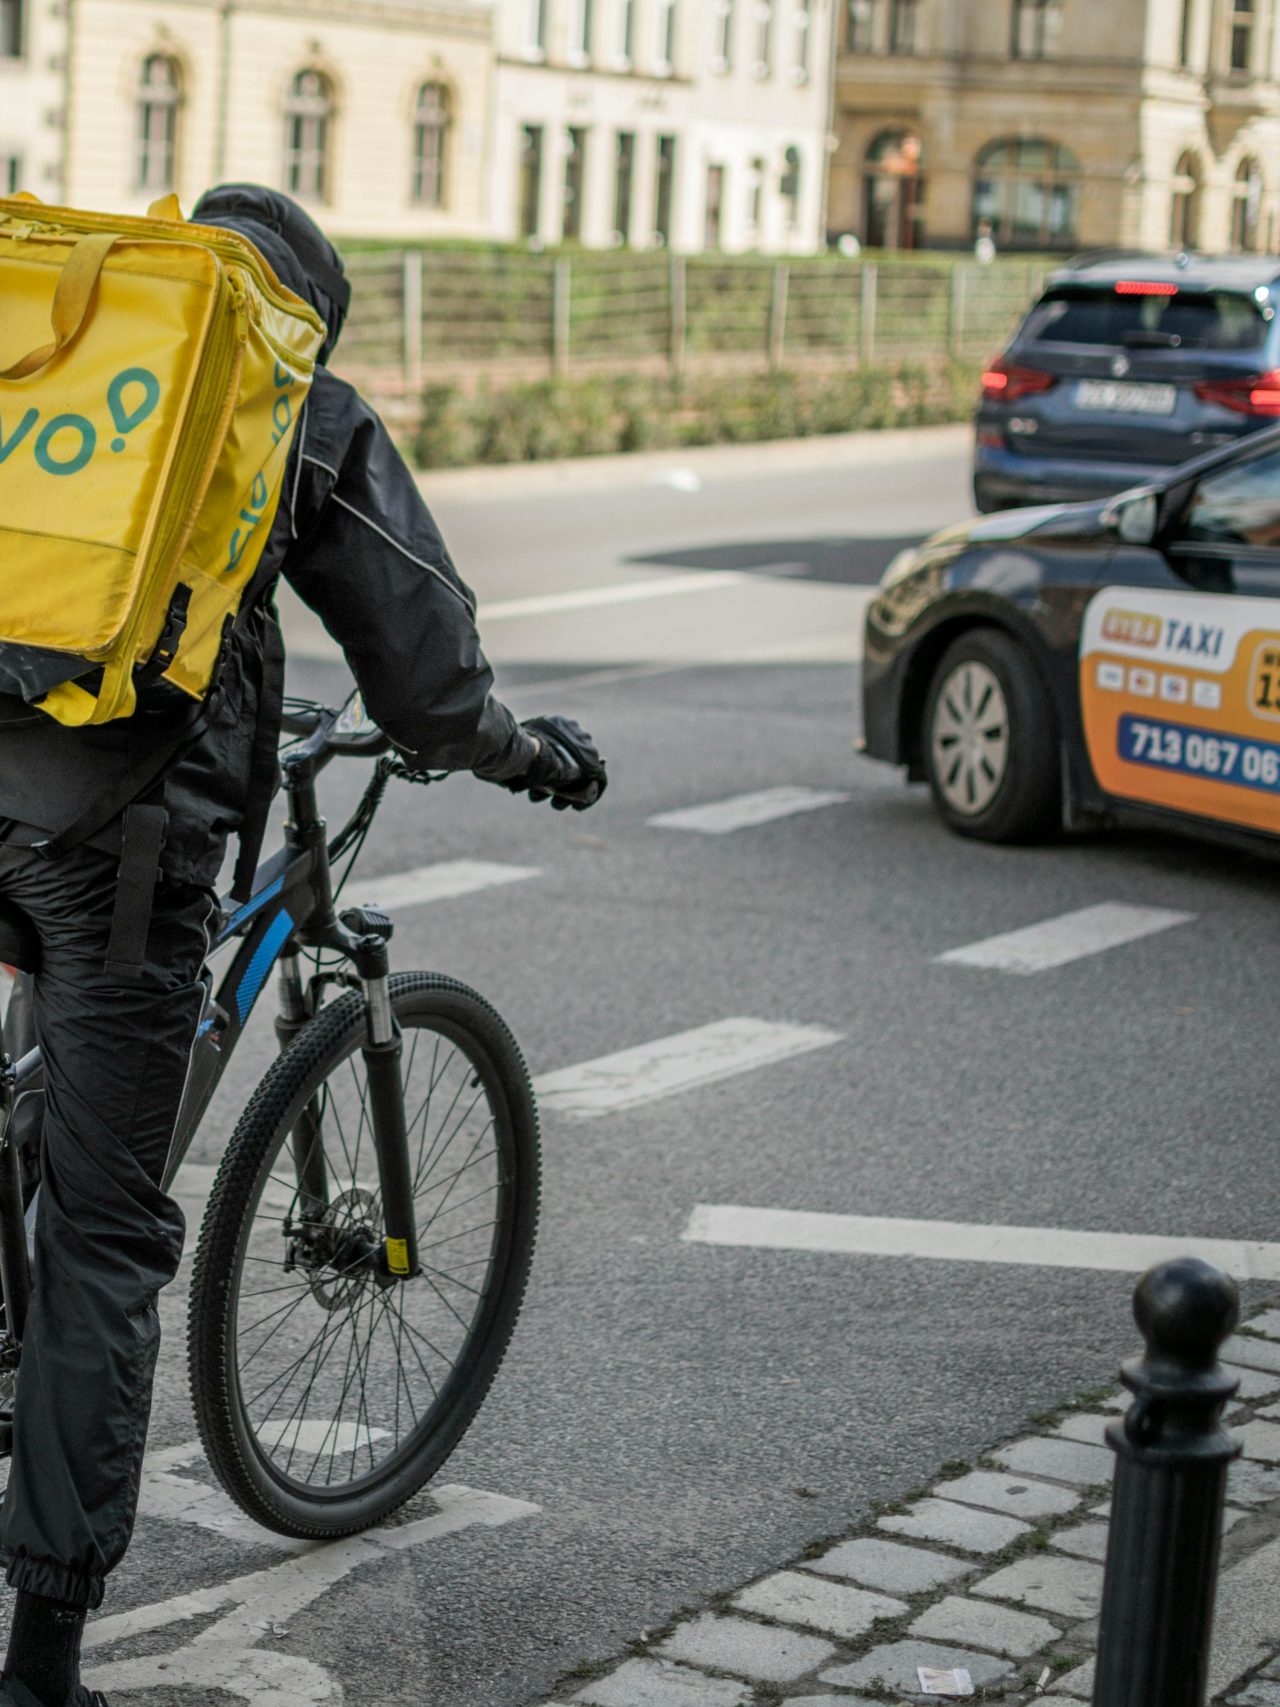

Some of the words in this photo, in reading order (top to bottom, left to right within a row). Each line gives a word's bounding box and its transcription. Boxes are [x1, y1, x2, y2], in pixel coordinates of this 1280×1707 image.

[1166, 618, 1224, 657] TAXI
[1131, 721, 1182, 765] 713
[1185, 734, 1239, 775] 067
[1241, 745, 1280, 785] 06
